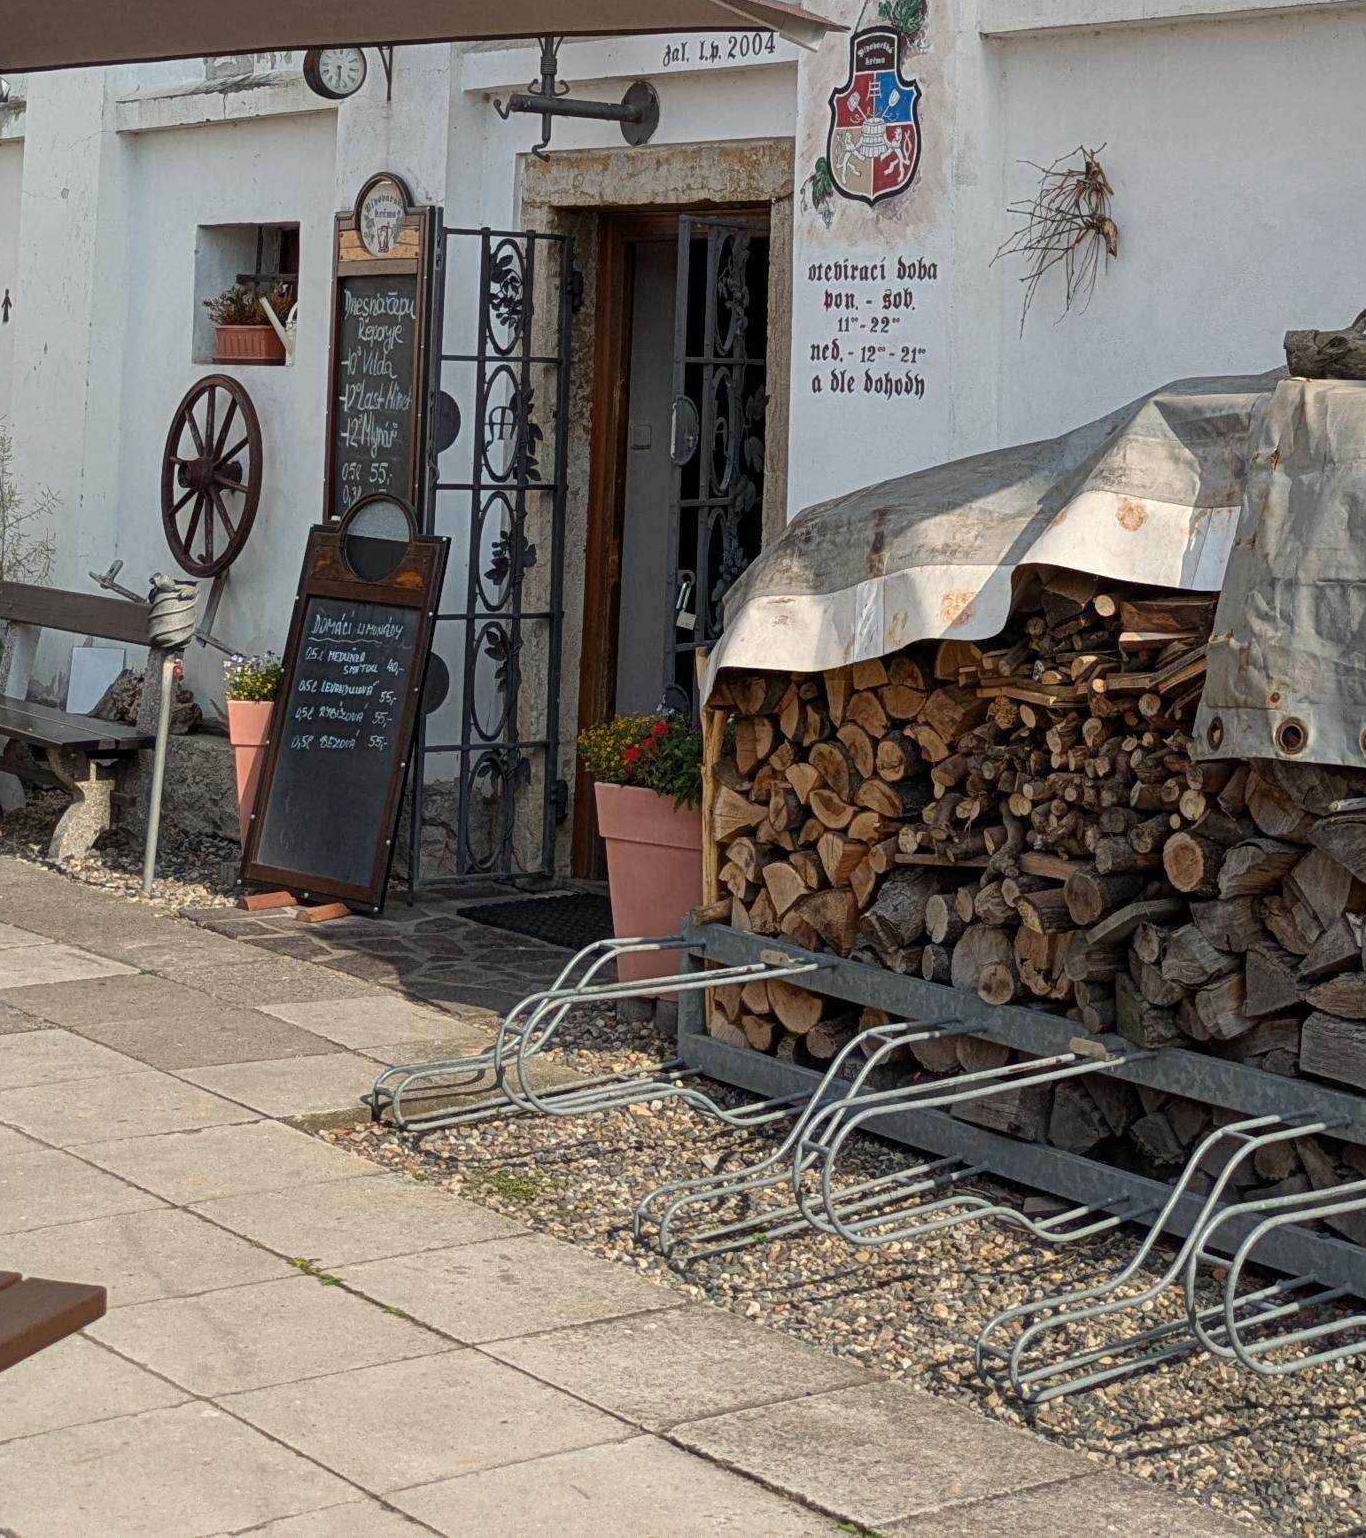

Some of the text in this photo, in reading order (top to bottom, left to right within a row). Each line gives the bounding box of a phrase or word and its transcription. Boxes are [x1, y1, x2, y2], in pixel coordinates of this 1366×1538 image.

[727, 32, 776, 60] 2004
[897, 256, 938, 281] doba
[823, 288, 859, 312] pon.
[810, 338, 843, 363] ned.
[811, 374, 823, 394] a
[830, 368, 855, 393] dle
